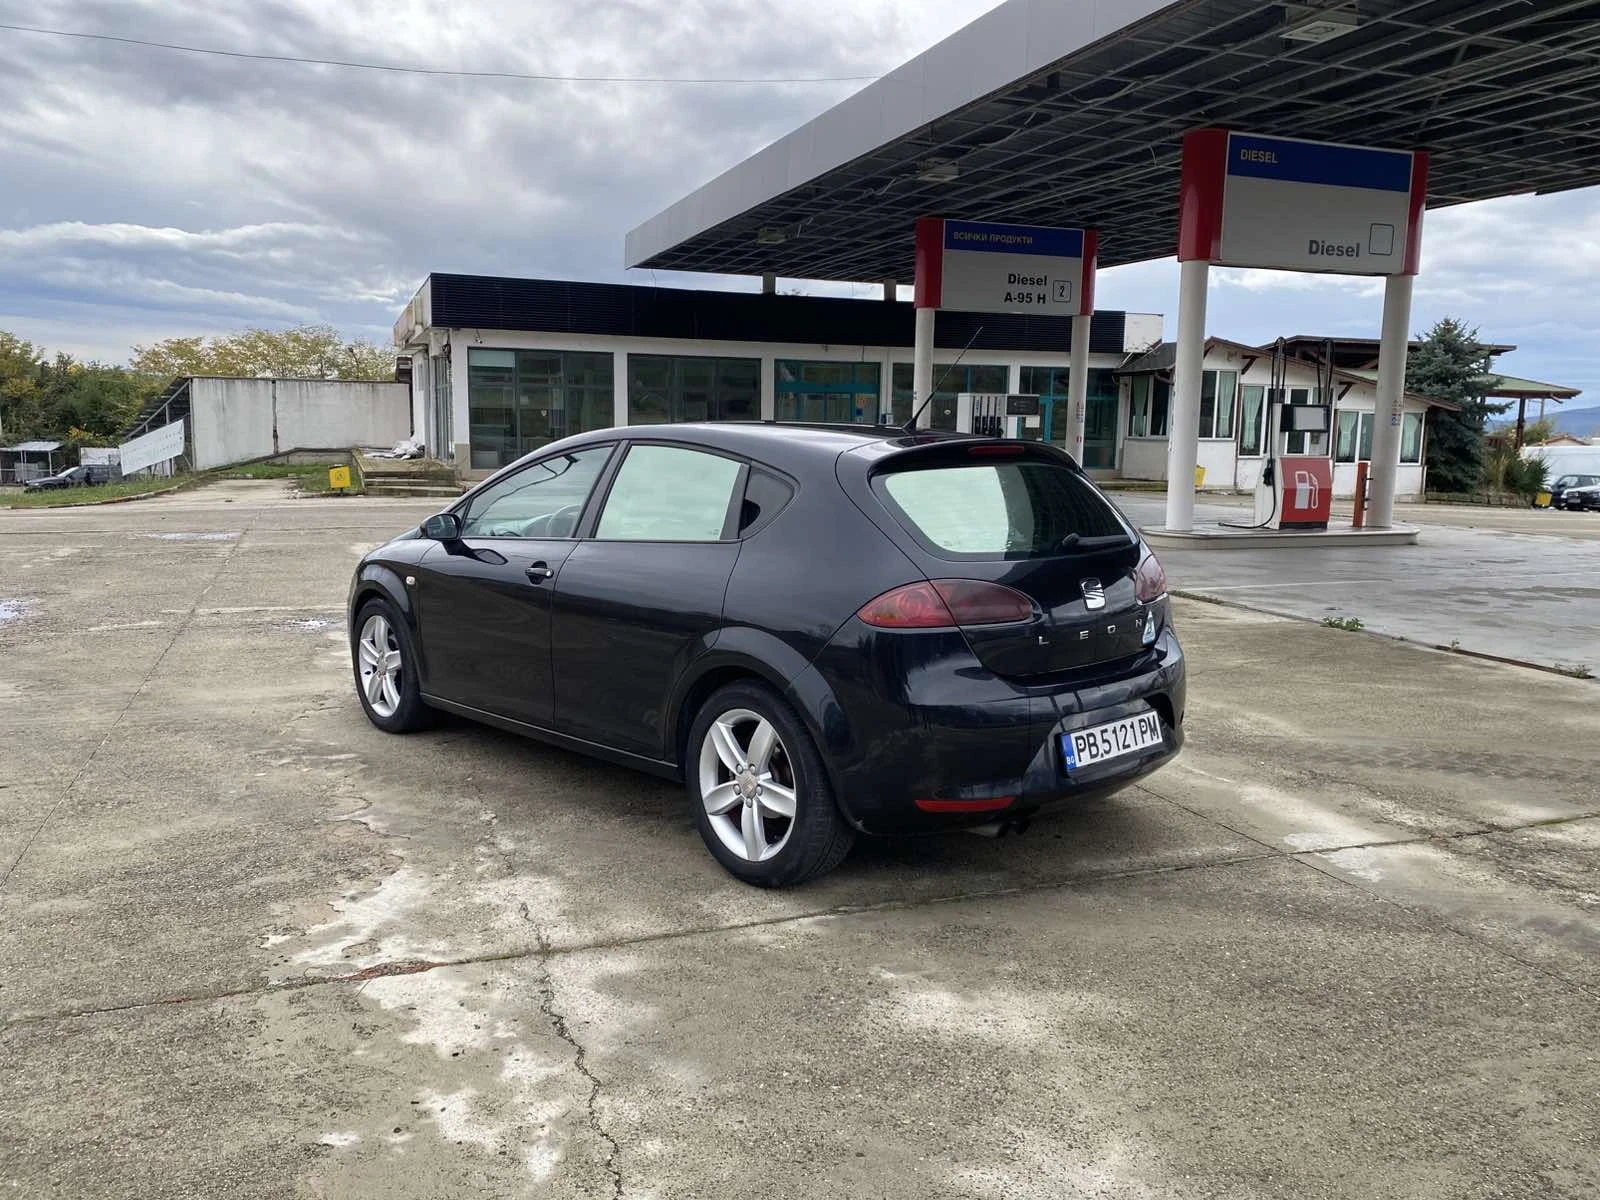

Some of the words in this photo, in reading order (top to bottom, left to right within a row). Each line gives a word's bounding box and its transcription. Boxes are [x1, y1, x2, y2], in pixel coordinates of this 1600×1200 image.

[1240, 149, 1278, 164] DIESEL
[953, 231, 987, 242] ВСИЧКИ
[989, 233, 1033, 245] ПРОДУКТИ
[1308, 239, 1360, 258] Diesel
[1008, 273, 1048, 286] Diesel
[1004, 292, 1033, 304] A-95
[1038, 618, 1143, 645] LEON
